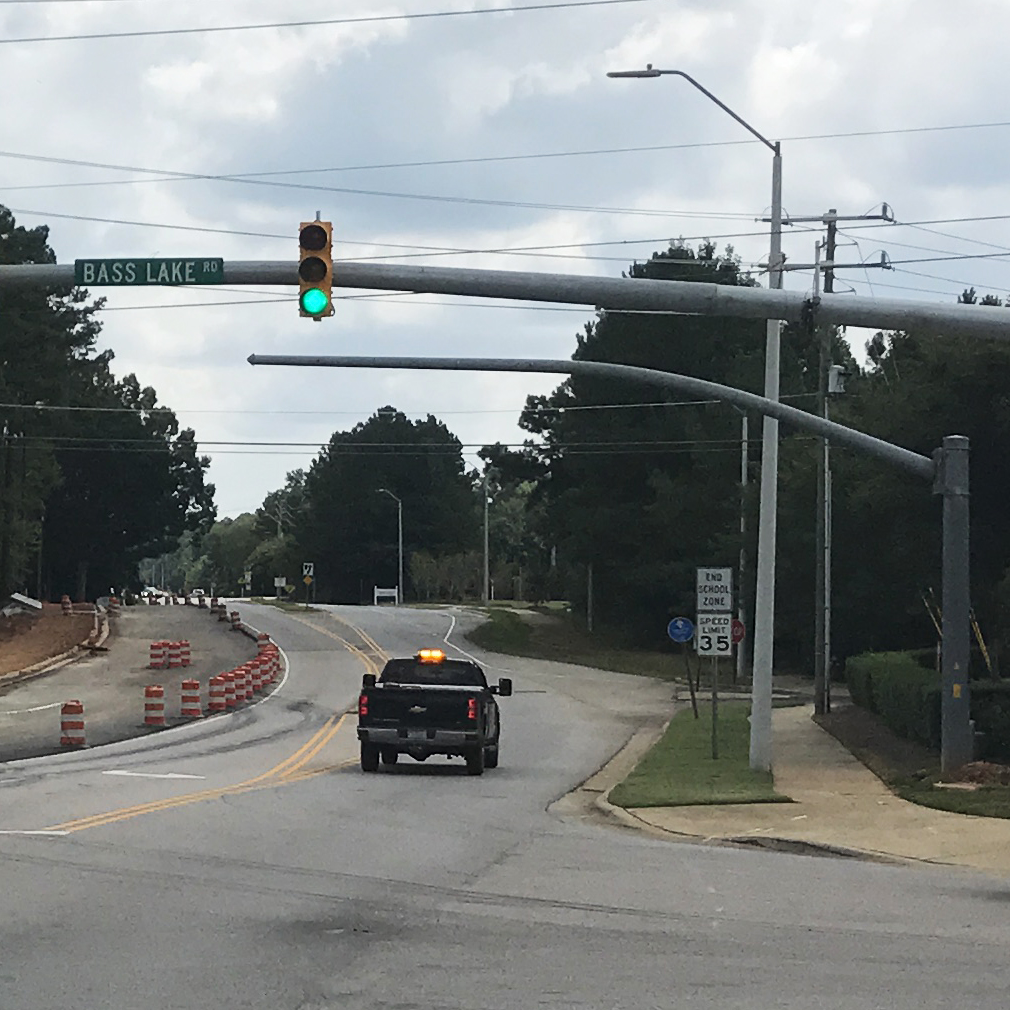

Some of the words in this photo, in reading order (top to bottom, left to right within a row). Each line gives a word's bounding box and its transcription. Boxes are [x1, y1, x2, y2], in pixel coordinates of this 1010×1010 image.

[83, 262, 136, 283] BASS
[146, 261, 196, 282] LAKE
[203, 261, 218, 272] RD
[705, 572, 722, 582] END
[698, 584, 730, 594] SCHOOL
[703, 597, 725, 606] ZONE
[699, 617, 729, 625] SPEED
[702, 626, 726, 634] LIMIT
[700, 635, 729, 651] 35
